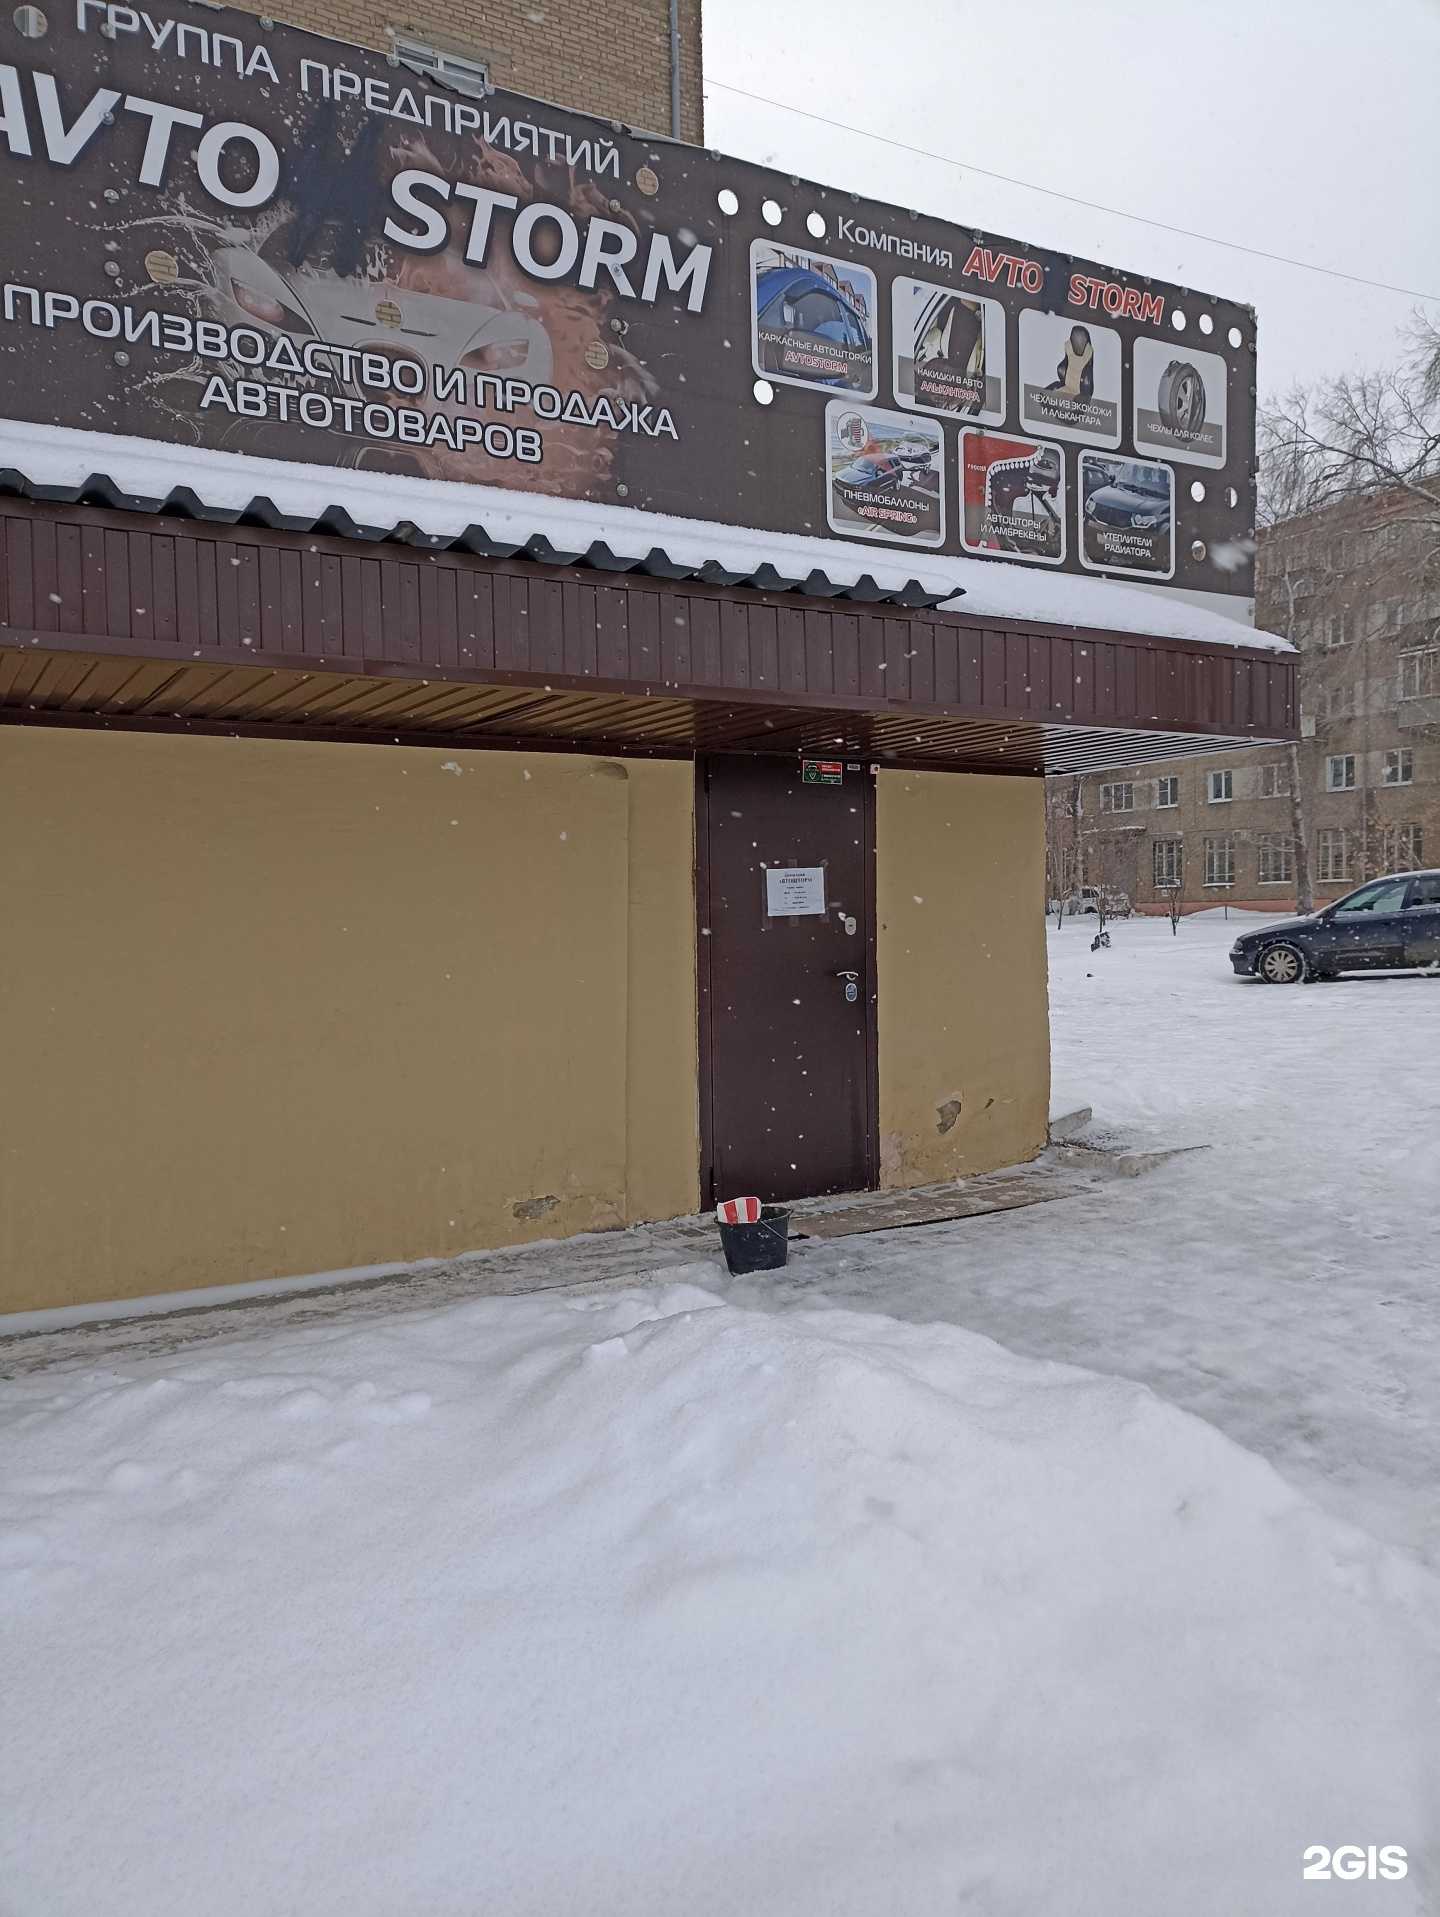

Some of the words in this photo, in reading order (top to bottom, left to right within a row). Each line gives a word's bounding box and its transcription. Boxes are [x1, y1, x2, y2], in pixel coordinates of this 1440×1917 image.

[75, 0, 281, 84] ГРУППА
[300, 58, 621, 178] ПРЕДПРИЯТИЙ
[383, 168, 713, 312] STORM
[838, 216, 953, 269] Компания
[962, 246, 1044, 294] AVTO
[1067, 273, 1165, 325] STORM
[758, 331, 812, 352] КАРКАСНЫЕ
[813, 343, 872, 364] АВТОШТОРКИ
[3, 283, 424, 395] ПРОИЗВОДСТВО
[434, 364, 466, 402] И
[475, 374, 679, 440] ПРОДАЖА
[784, 349, 848, 374] AVTOSTORM
[917, 367, 955, 382] НАКИДКИ
[956, 375, 962, 384] В
[962, 377, 983, 389] АВТО
[920, 380, 981, 402] АЛЬКАНТАРА
[1030, 393, 1059, 406] ЧЕХЛЫ
[1060, 399, 1071, 409] ИЗ
[1071, 401, 1112, 417] ЭКОКОЖИ
[1041, 407, 1049, 415] И
[1049, 408, 1101, 426] АЛЬКАНТАРА
[201, 376, 542, 462] АВТОТОВАРОВ
[1147, 423, 1173, 435] ЧЕХЛЫ
[1173, 428, 1190, 439] ДЛЯ
[844, 489, 929, 512] ПНЕВМОБАЛЛОНЫ
[986, 513, 1041, 529] АВТОШТОРЫ
[980, 524, 988, 533] И
[988, 525, 1047, 542] ЛАМБРЕКЕНЫ
[1103, 532, 1153, 547] УТЕПЛИТЕЛИ
[1104, 543, 1151, 558] РАДИАТОРА
